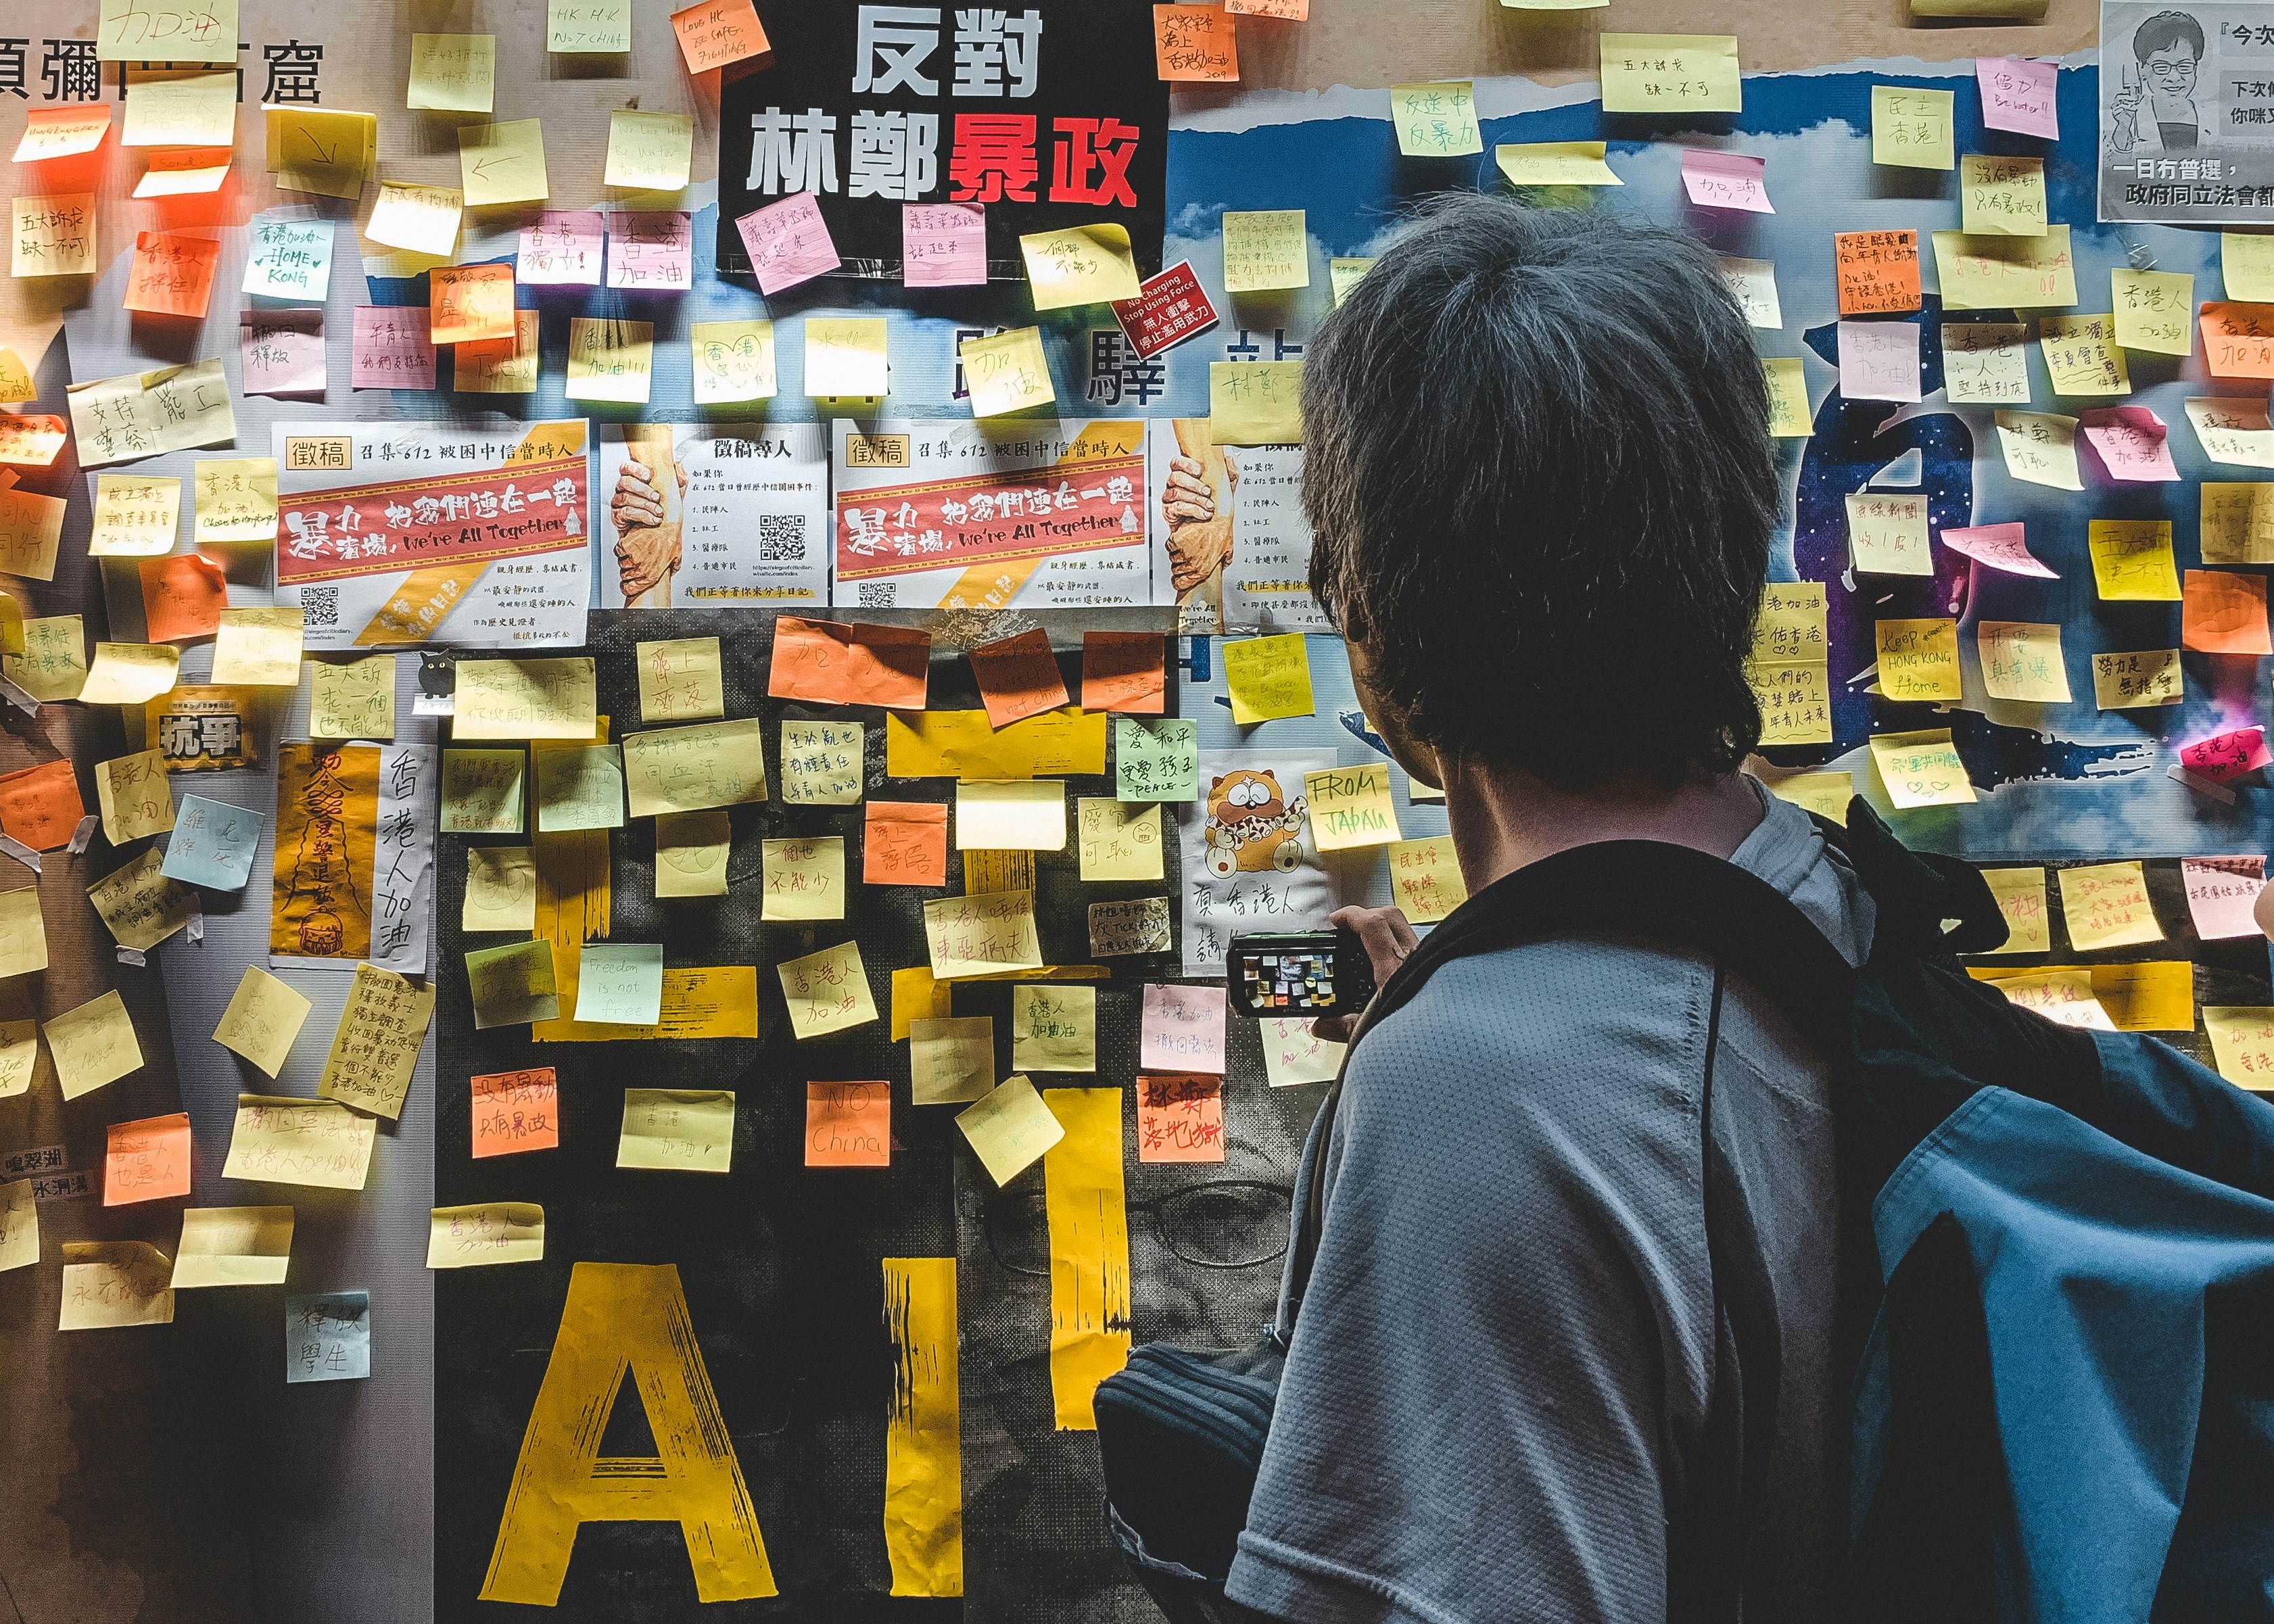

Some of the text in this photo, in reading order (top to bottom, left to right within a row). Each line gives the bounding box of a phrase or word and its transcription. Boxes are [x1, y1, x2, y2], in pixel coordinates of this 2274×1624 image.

[851, 5, 1043, 98] 反對
[1405, 87, 1471, 116] 反送中
[1644, 81, 1711, 98] 缺一不可
[1888, 95, 1939, 117] 民主
[1409, 122, 1474, 152] 反暴力
[746, 106, 1140, 208] 林鄭暴政
[529, 217, 577, 247] 香港
[621, 216, 684, 259] 香港
[268, 269, 308, 288] KONG
[617, 264, 684, 287] 加油
[1141, 274, 1182, 301] Charging
[1123, 279, 1195, 325] Stop Using Force
[2123, 284, 2189, 312] 香港人
[1138, 303, 1210, 351] 停止濫用武力
[1142, 297, 1193, 332] 無人衝擊
[292, 441, 345, 467] 徵稿
[713, 438, 793, 459] 徵稿尋人
[851, 438, 903, 464] 徵稿
[691, 469, 724, 479] 如果你
[1242, 462, 1275, 473] 如果你
[403, 518, 567, 551] We're All Together
[957, 515, 1122, 548] We're All Together
[701, 562, 737, 571] 普通市民
[1881, 628, 1918, 653] Keep
[1888, 650, 1953, 669] HONG KONG
[160, 717, 241, 758] 抗爭
[1307, 772, 1377, 803] FROM
[377, 747, 419, 950] 香港人加油
[769, 869, 830, 895] 不能少
[617, 981, 640, 993] not
[795, 958, 859, 994] 香港人
[602, 999, 643, 1017] free
[805, 988, 856, 1026] 加油
[1026, 998, 1066, 1018] 香港人
[826, 1086, 871, 1114] NO
[811, 1126, 888, 1157] China
[300, 1303, 364, 1334] 釋放
[300, 1343, 348, 1375] 學生
